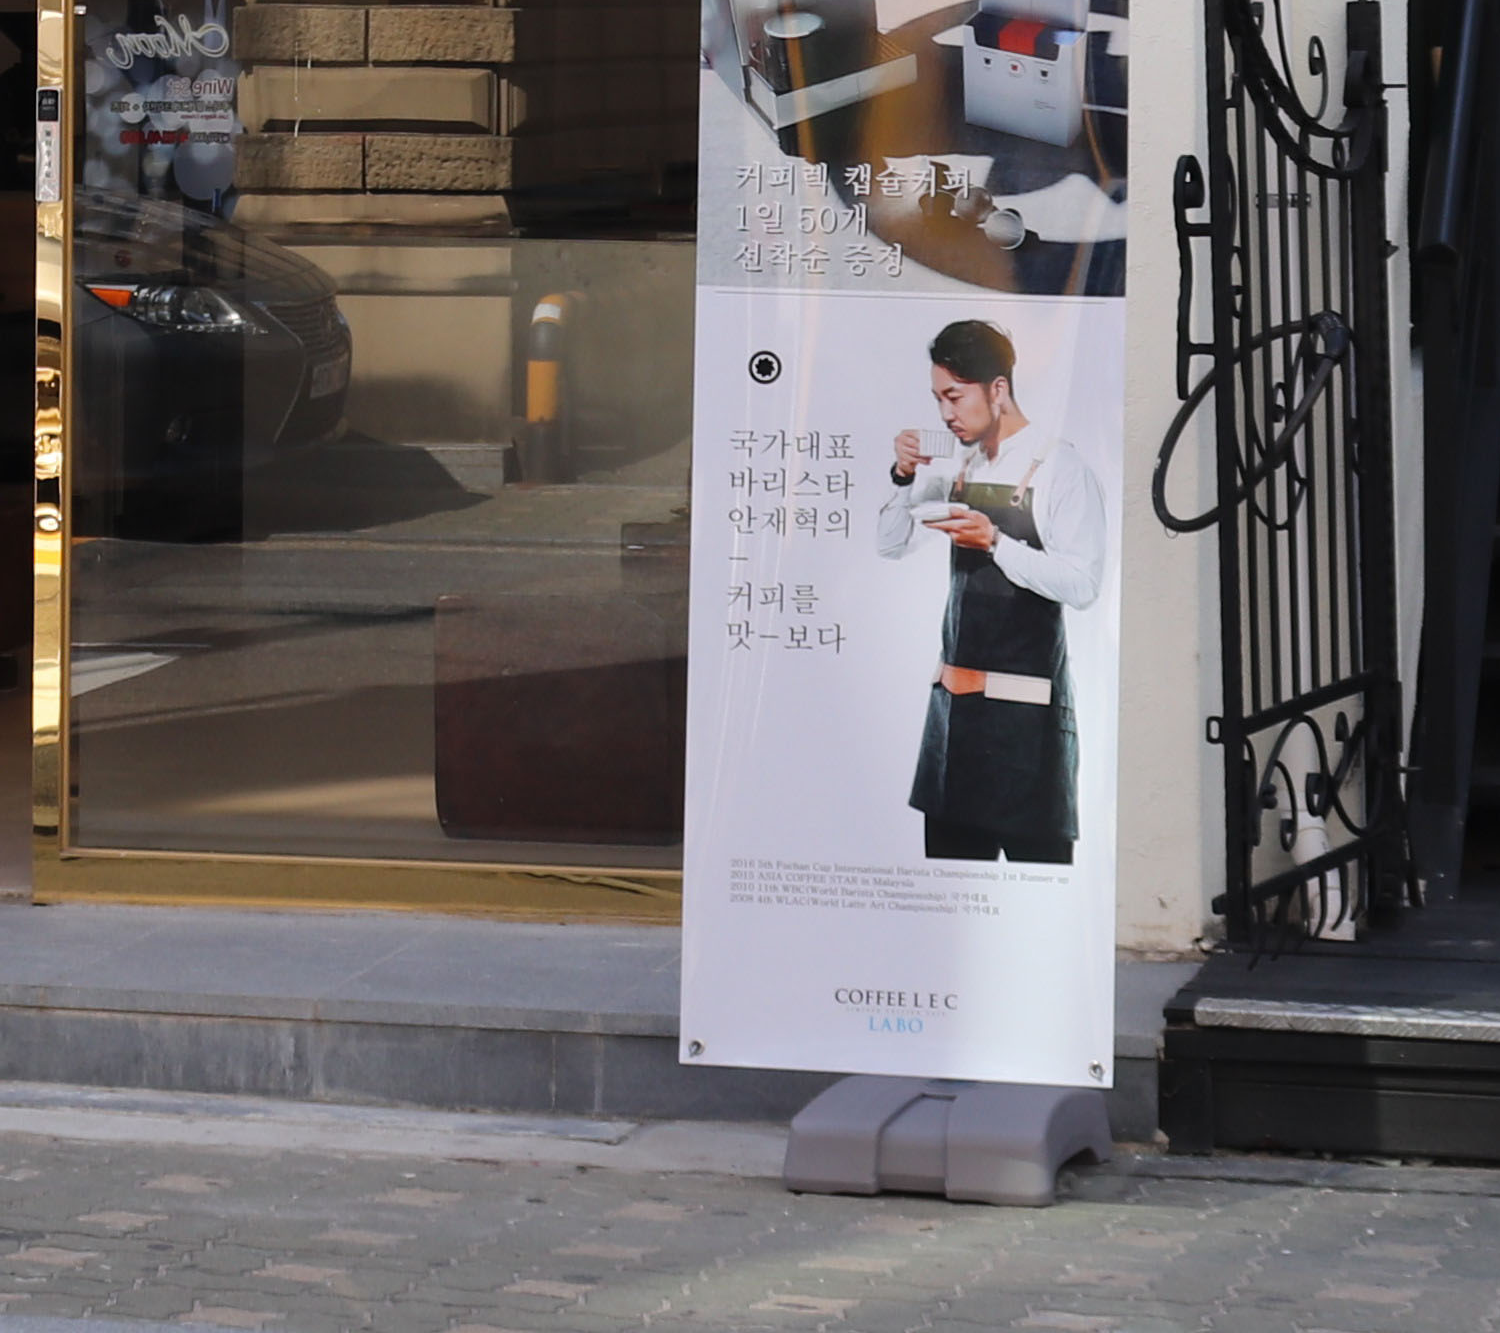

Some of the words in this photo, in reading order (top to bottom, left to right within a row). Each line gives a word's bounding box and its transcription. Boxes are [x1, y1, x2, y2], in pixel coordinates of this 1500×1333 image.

[843, 162, 972, 200] 캡슐커피
[735, 200, 784, 235] 1일
[798, 201, 870, 237] 50개
[733, 241, 832, 275] 선착순
[842, 242, 906, 279] 증정
[728, 427, 856, 464] 국가대표
[728, 464, 856, 501] 바리스타
[727, 503, 853, 540] 안재혁의
[726, 581, 821, 617] 커피를
[834, 987, 907, 1008] COFFEE
[868, 1014, 925, 1034] LABO
